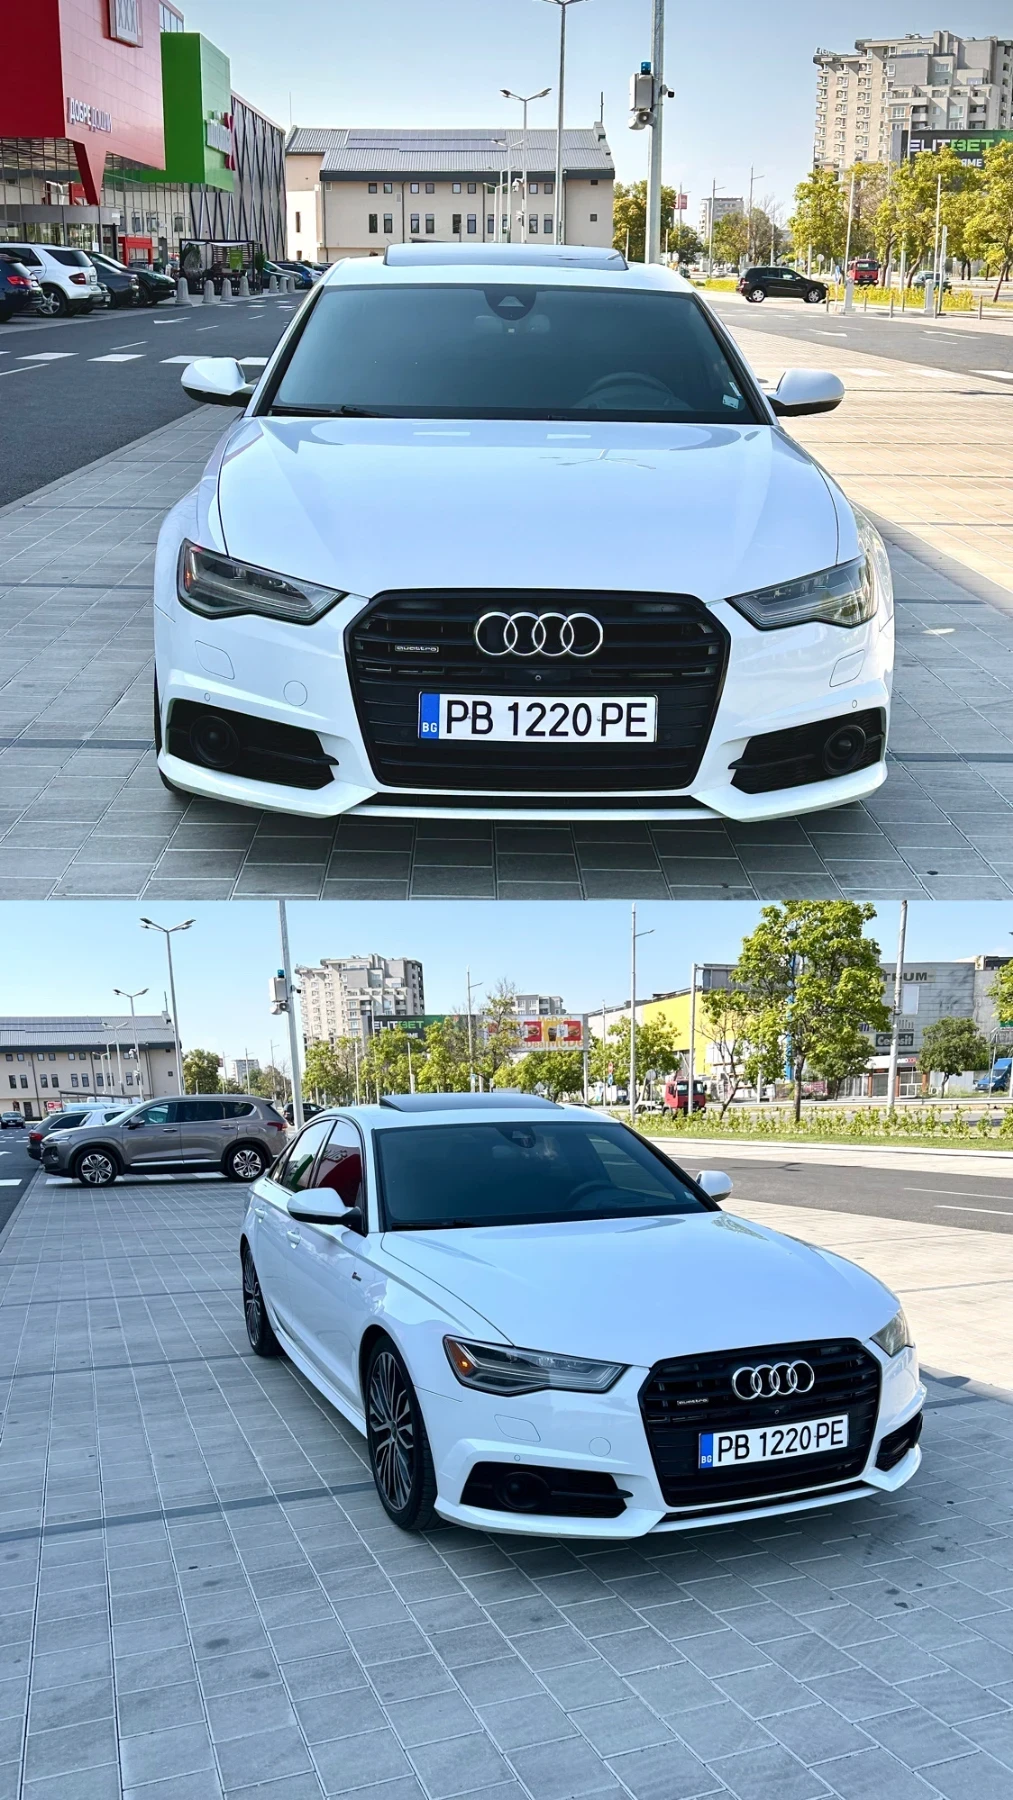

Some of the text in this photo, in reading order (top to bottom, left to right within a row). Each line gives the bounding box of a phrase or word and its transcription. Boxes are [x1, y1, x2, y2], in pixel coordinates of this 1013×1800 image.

[909, 138, 995, 152] ELITBET
[446, 700, 648, 737] PB 1220 PE
[422, 722, 438, 733] BG
[718, 1419, 844, 1462] PB 1220 PE
[701, 1455, 713, 1464] BG
